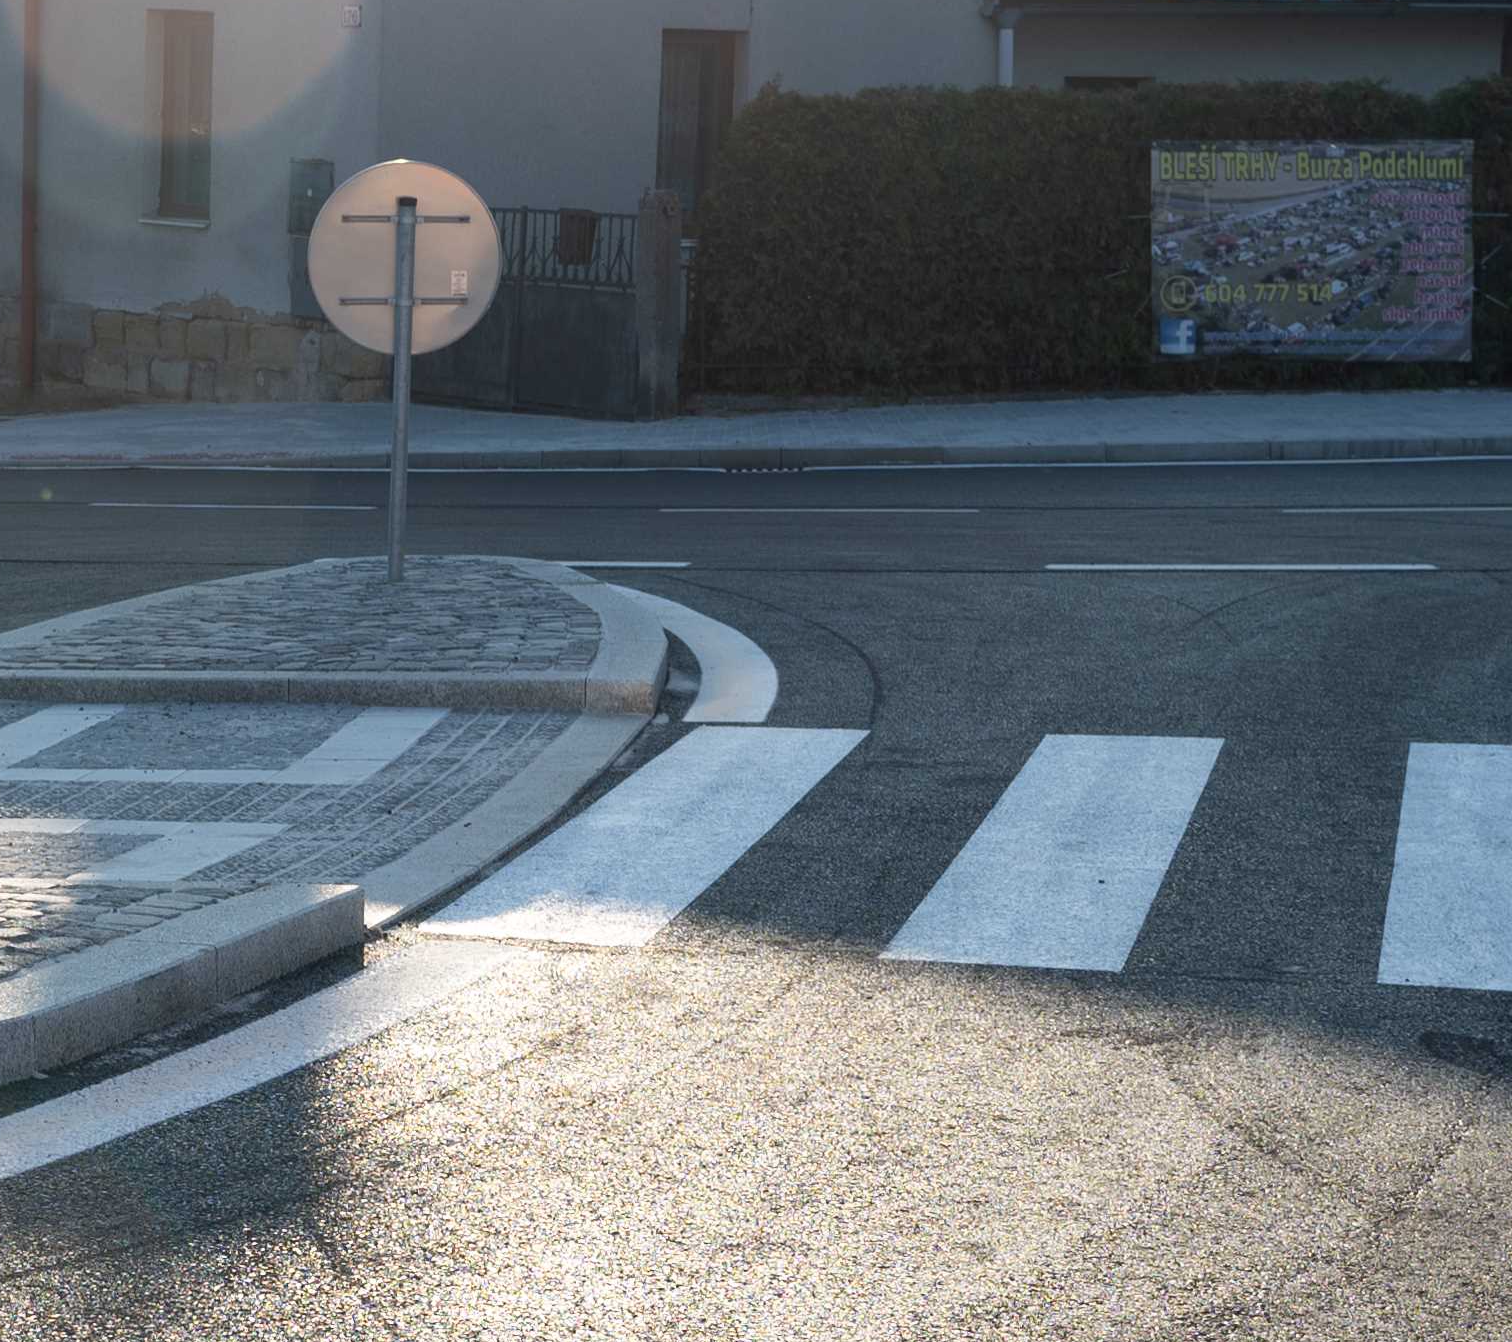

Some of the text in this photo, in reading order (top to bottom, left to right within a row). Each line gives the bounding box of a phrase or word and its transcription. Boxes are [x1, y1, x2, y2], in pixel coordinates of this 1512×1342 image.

[1160, 145, 1216, 180] BLEŠÍ
[1223, 151, 1279, 180] TRHY
[1297, 151, 1353, 180] Burza
[1359, 149, 1464, 180] Podchlumí
[1205, 284, 1332, 303] 604 777 514
